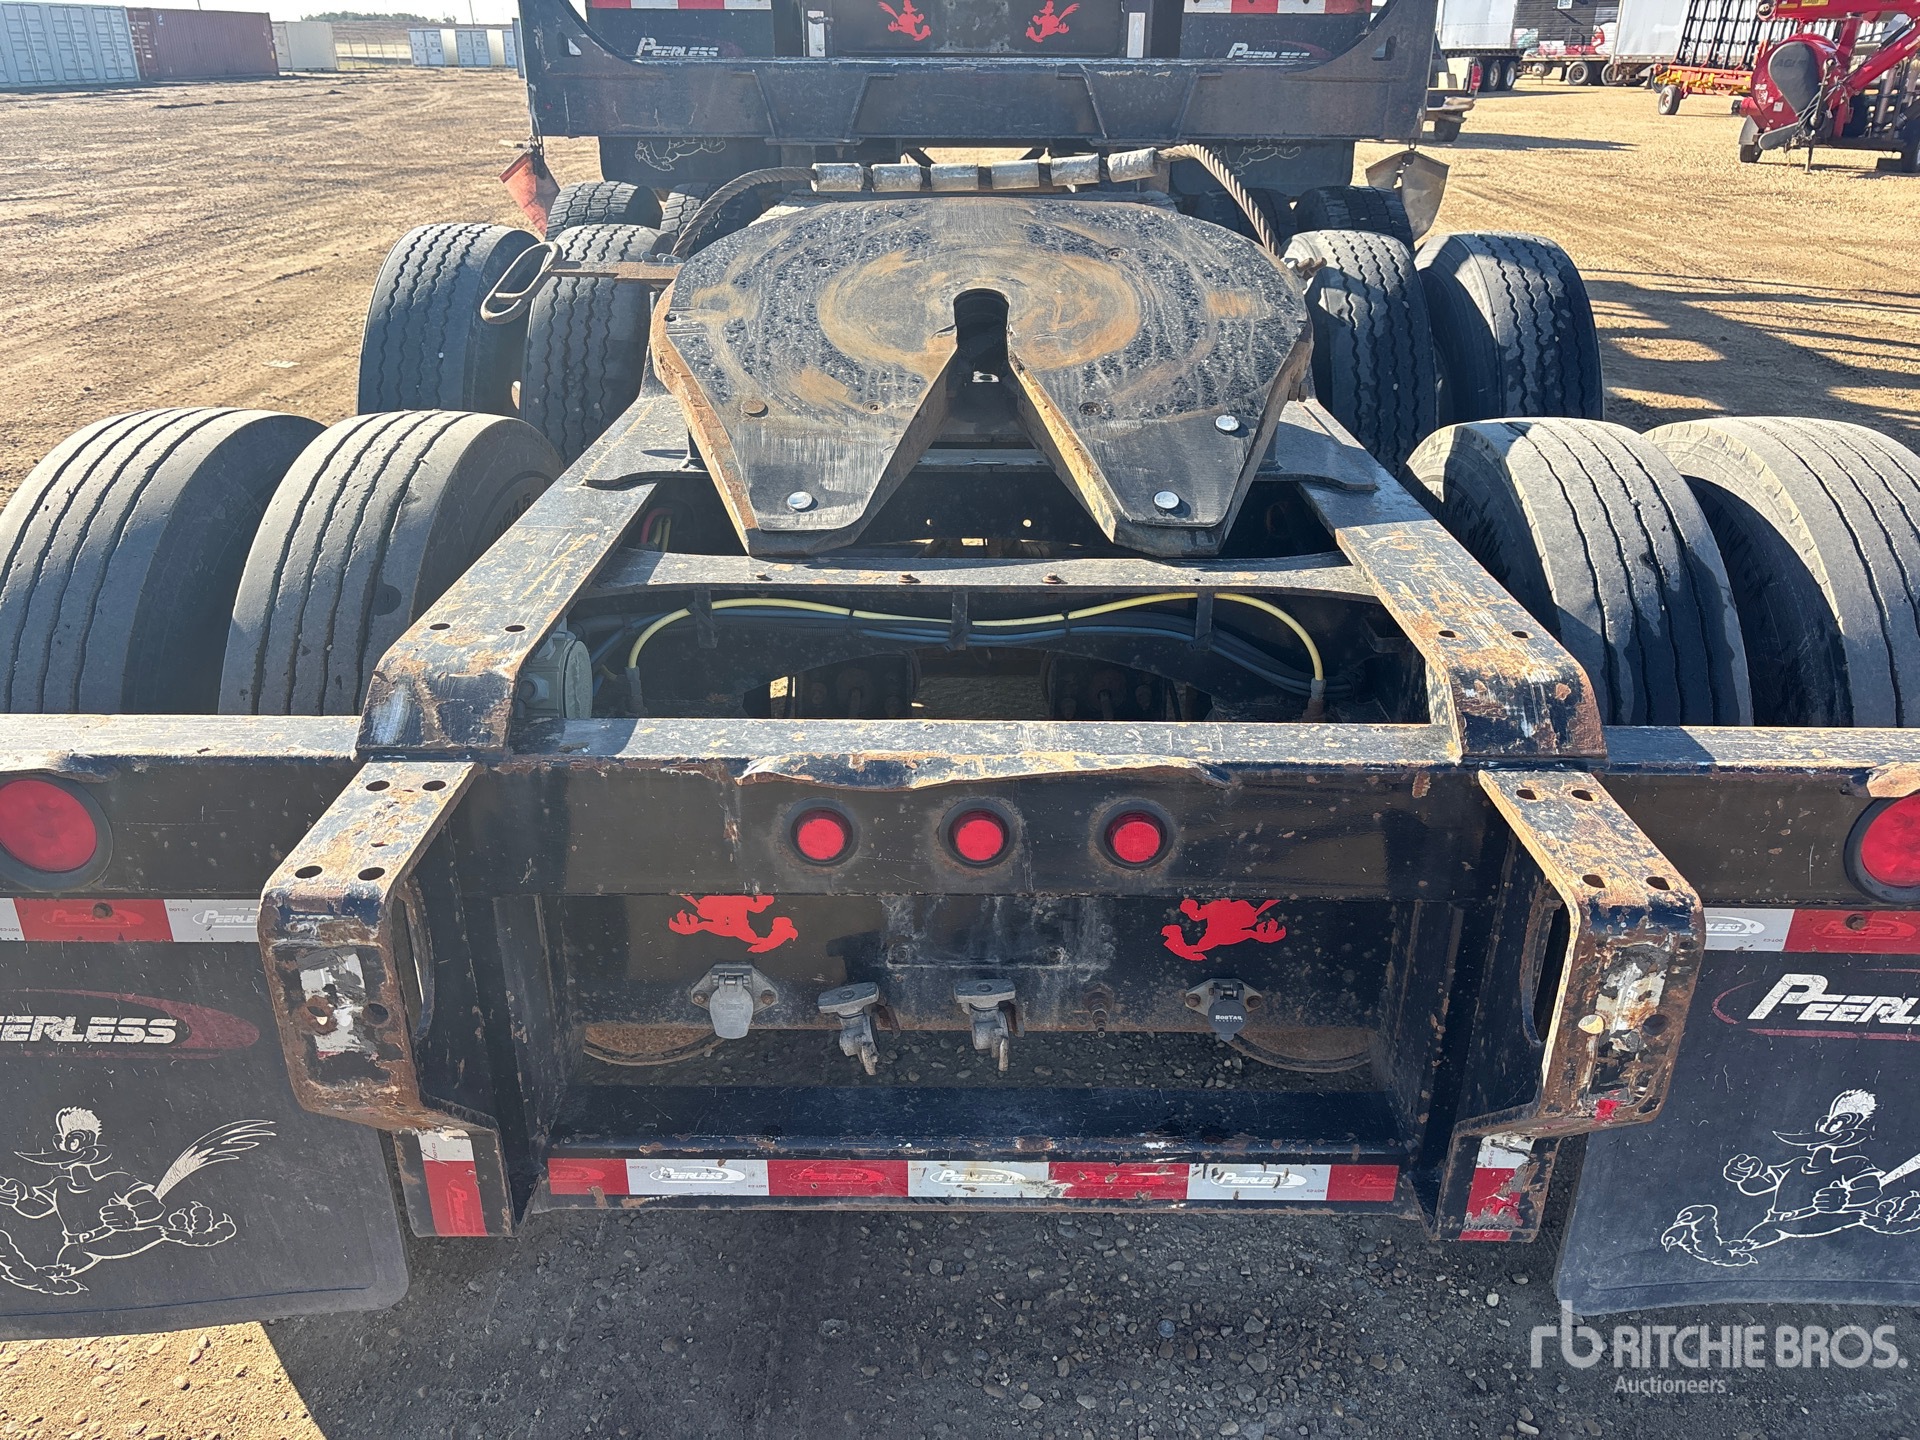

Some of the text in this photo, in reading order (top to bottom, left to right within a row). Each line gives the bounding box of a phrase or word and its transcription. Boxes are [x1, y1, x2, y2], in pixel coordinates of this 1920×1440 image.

[202, 910, 258, 924] PEERLE
[1747, 973, 1920, 1025] PEERL
[0, 1015, 178, 1044] ERLESS
